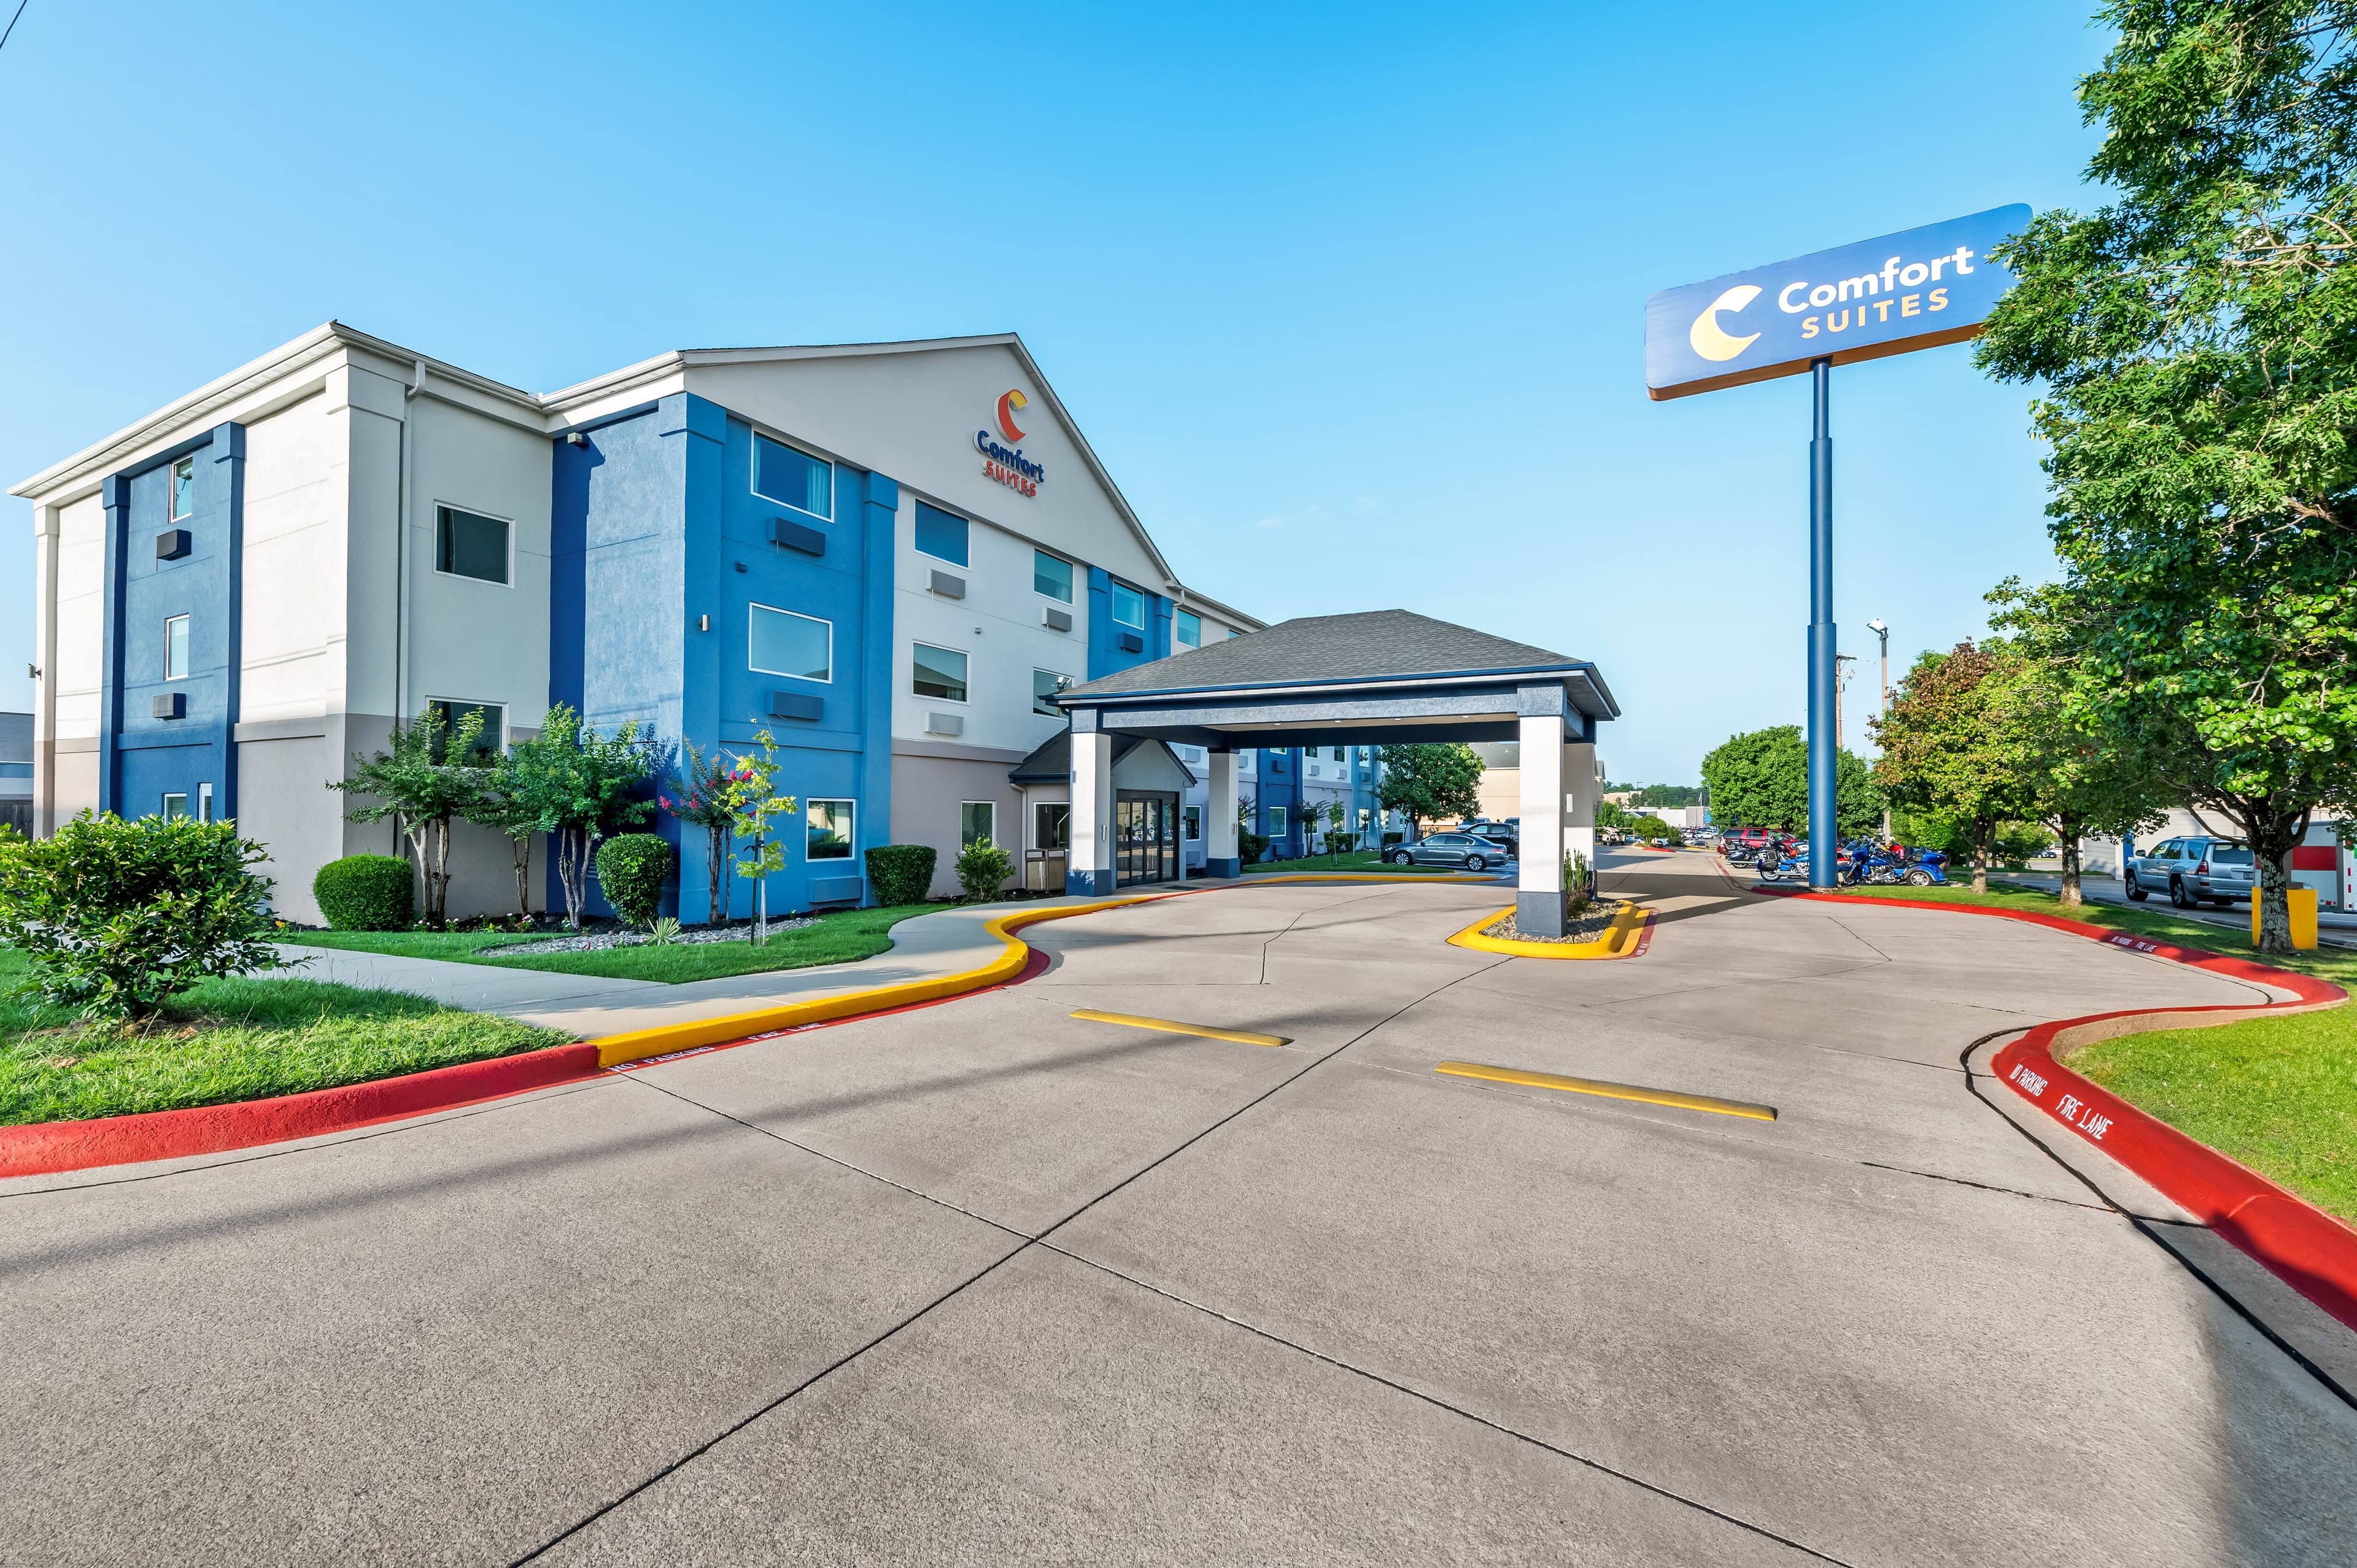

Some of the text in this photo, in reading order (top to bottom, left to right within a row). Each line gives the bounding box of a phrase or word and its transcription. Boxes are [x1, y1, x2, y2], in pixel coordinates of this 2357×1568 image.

[1779, 246, 1974, 314] Comfort
[1802, 288, 1949, 339] SUITES
[973, 430, 1044, 484] Comfort
[983, 460, 1037, 497] SUITES
[606, 1022, 828, 1072] NO PARKING FIRE LANE
[2009, 1063, 2113, 1140] NO PARKING FIRE LANE
